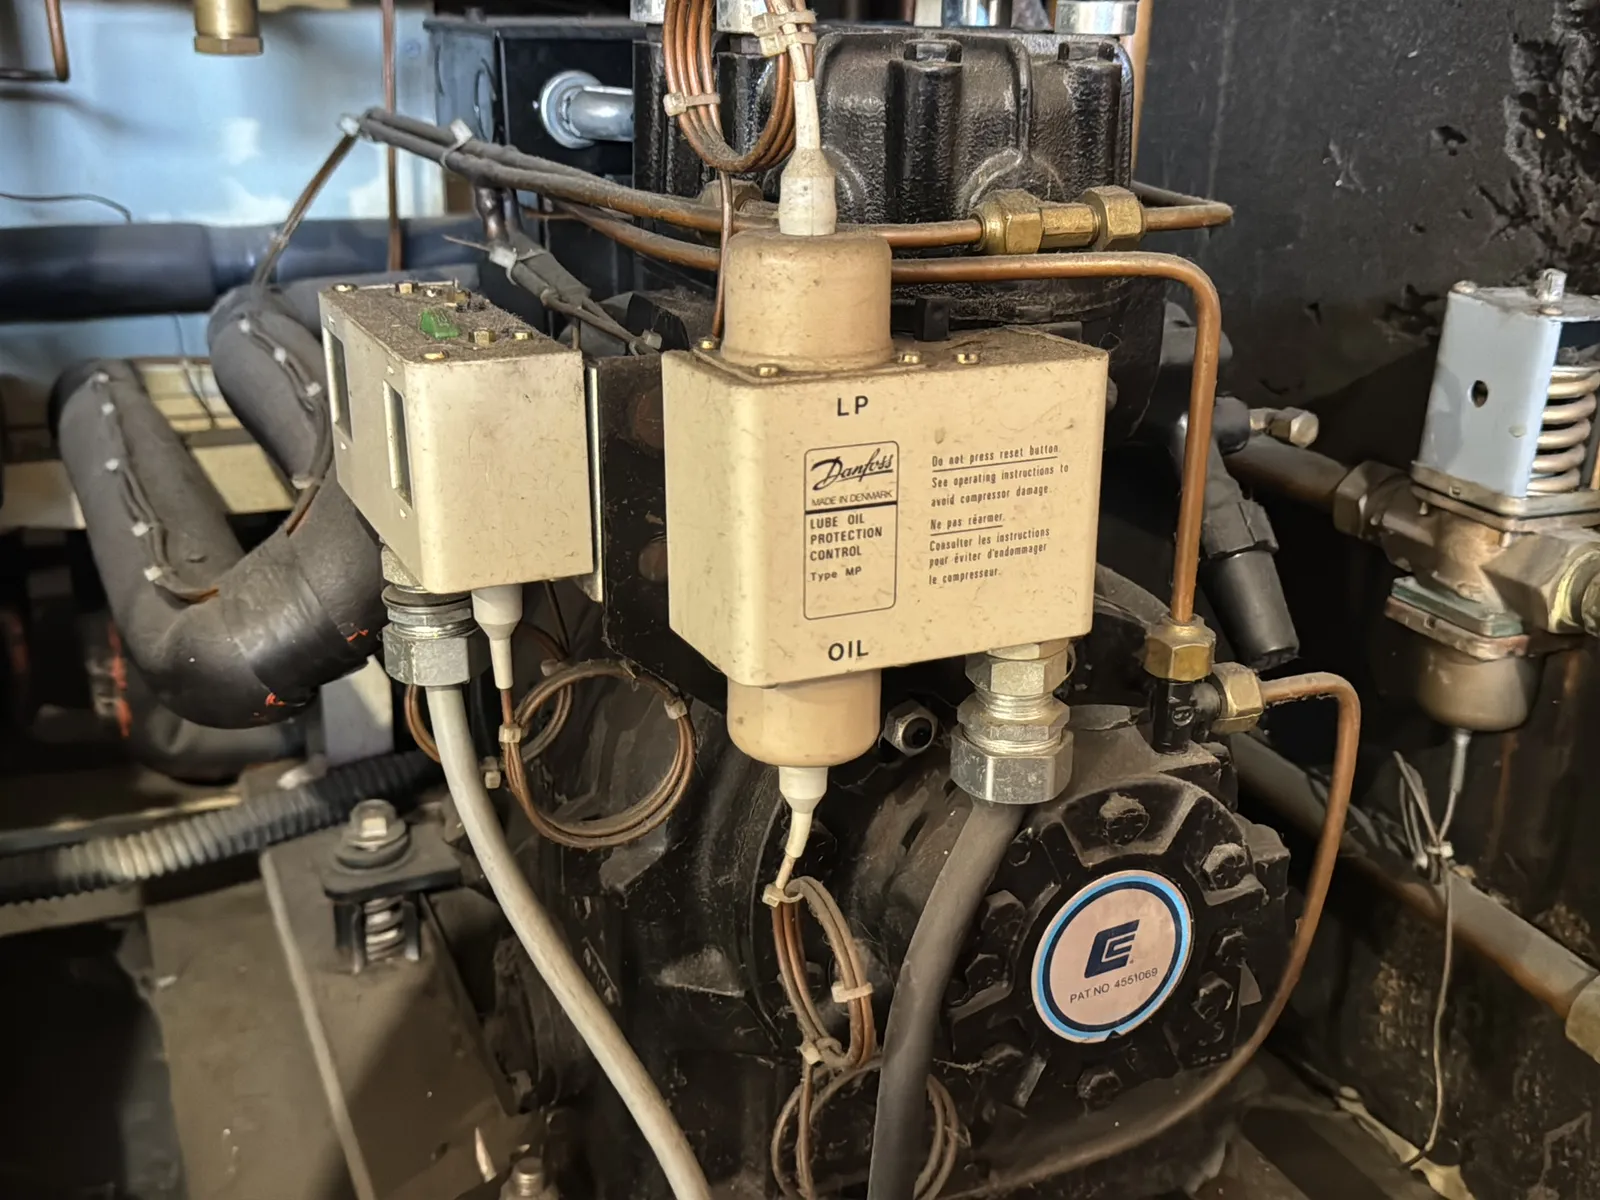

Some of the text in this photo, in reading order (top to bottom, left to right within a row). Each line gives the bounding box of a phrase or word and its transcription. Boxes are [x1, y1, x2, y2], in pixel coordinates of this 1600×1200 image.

[837, 395, 868, 416] LP
[932, 455, 943, 467] Do
[948, 454, 964, 465] not
[969, 451, 994, 465] press
[1000, 447, 1023, 459] reset
[810, 447, 894, 491] Danfoss
[932, 464, 1069, 488] See operating instructions to
[811, 490, 893, 506] MADE IN DENMARK
[931, 494, 955, 507] avoid
[960, 489, 1010, 504] compressor
[810, 513, 865, 529] LUBE OIL
[930, 519, 942, 530] Ne
[946, 518, 962, 530] pas
[810, 526, 883, 544] PROTECTION
[929, 528, 1050, 551] Consulter les instructions
[810, 545, 862, 561] CONTROL
[929, 543, 1047, 569] pour éviter d'endommager
[810, 566, 862, 582] Type MP
[929, 575, 937, 585] le
[828, 639, 869, 661] OIL
[1114, 967, 1158, 988] 4551069
